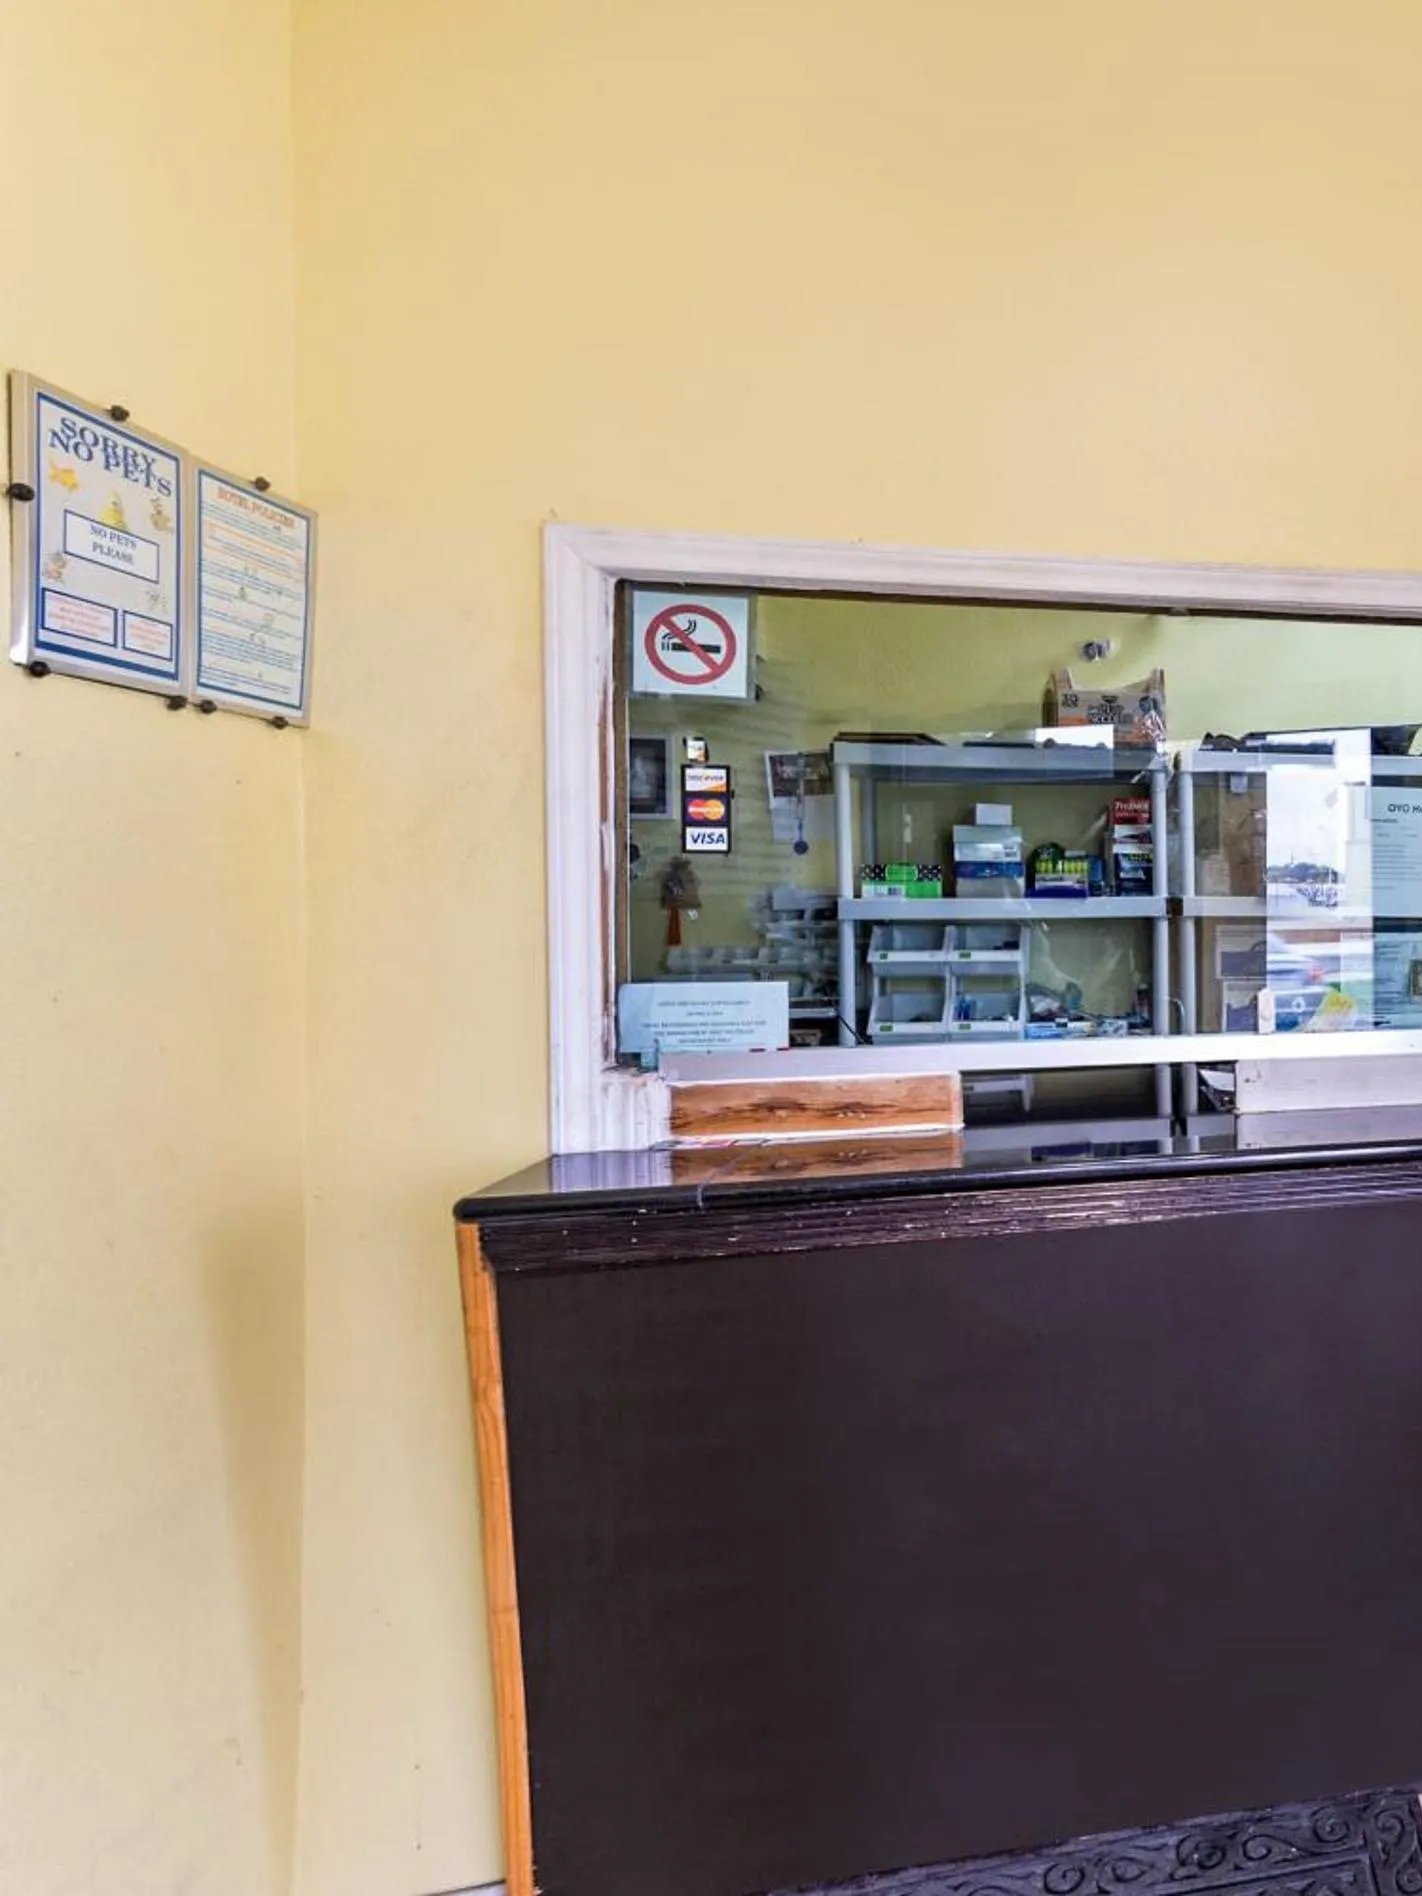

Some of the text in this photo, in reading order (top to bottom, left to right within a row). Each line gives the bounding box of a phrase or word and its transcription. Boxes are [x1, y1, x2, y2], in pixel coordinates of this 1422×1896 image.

[60, 416, 157, 472] SORRY
[49, 429, 172, 497] NO PETS
[90, 524, 137, 549] NO PETS
[92, 541, 134, 564] PLEASE
[1387, 803, 1411, 813] OYO
[690, 832, 725, 844] VISA
